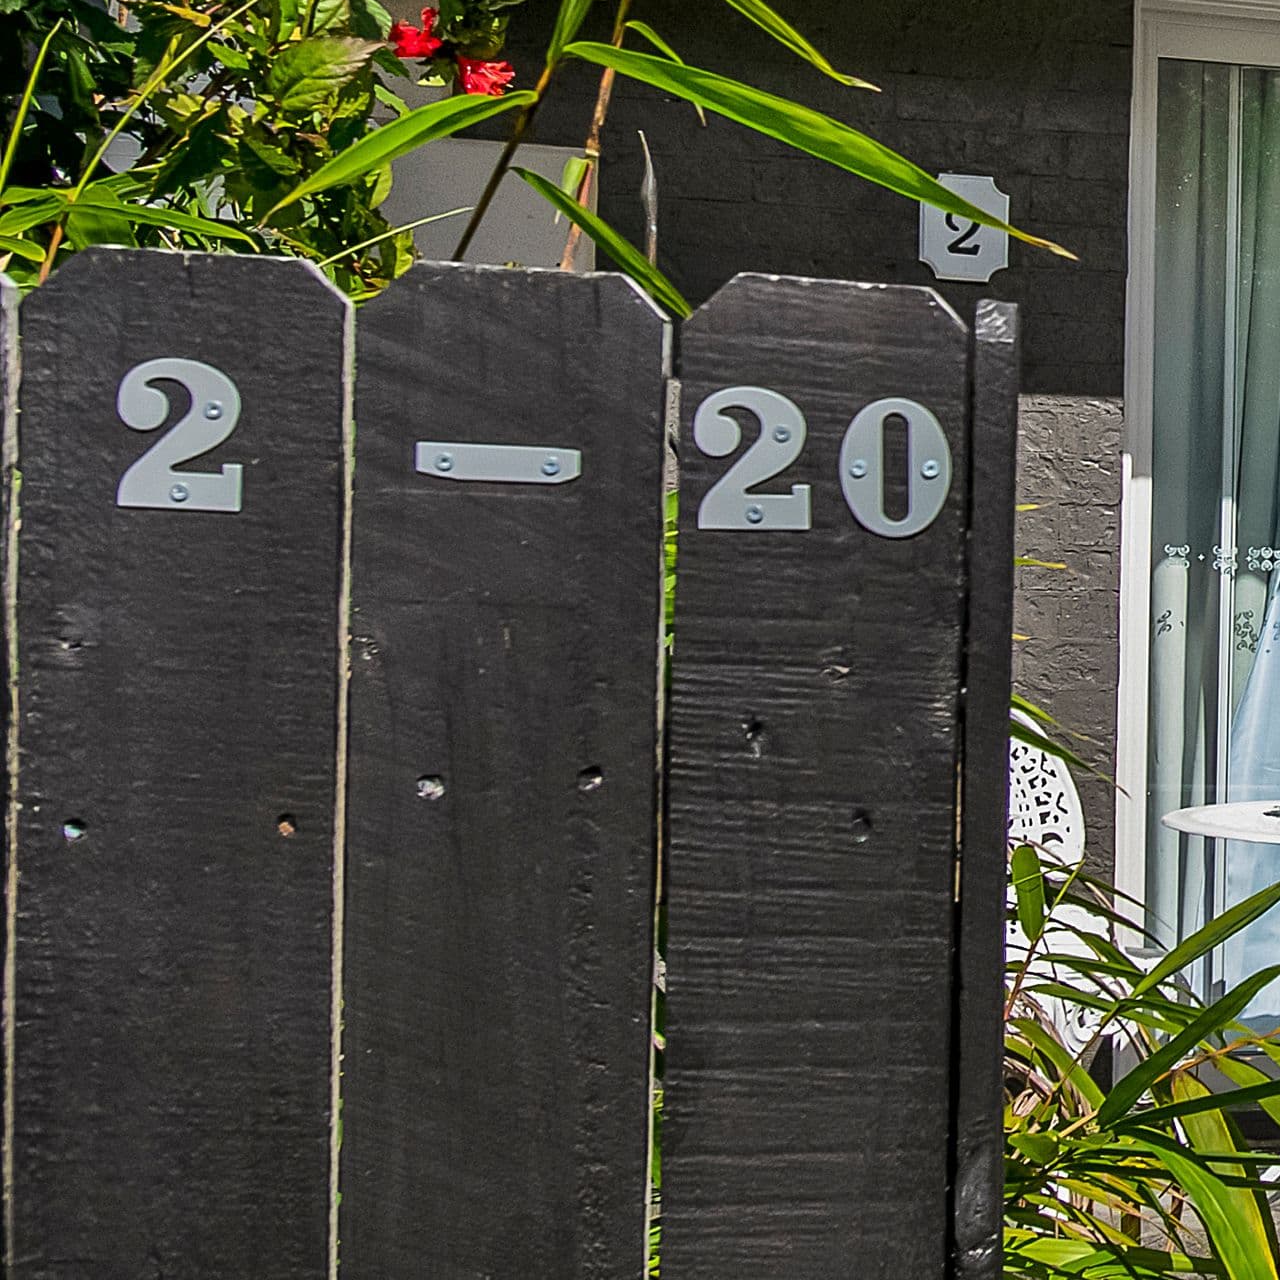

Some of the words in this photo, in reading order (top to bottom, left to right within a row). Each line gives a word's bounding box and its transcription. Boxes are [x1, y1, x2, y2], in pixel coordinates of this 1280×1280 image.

[945, 212, 981, 256] 2
[116, 358, 242, 513] 2
[692, 386, 952, 538] 20
